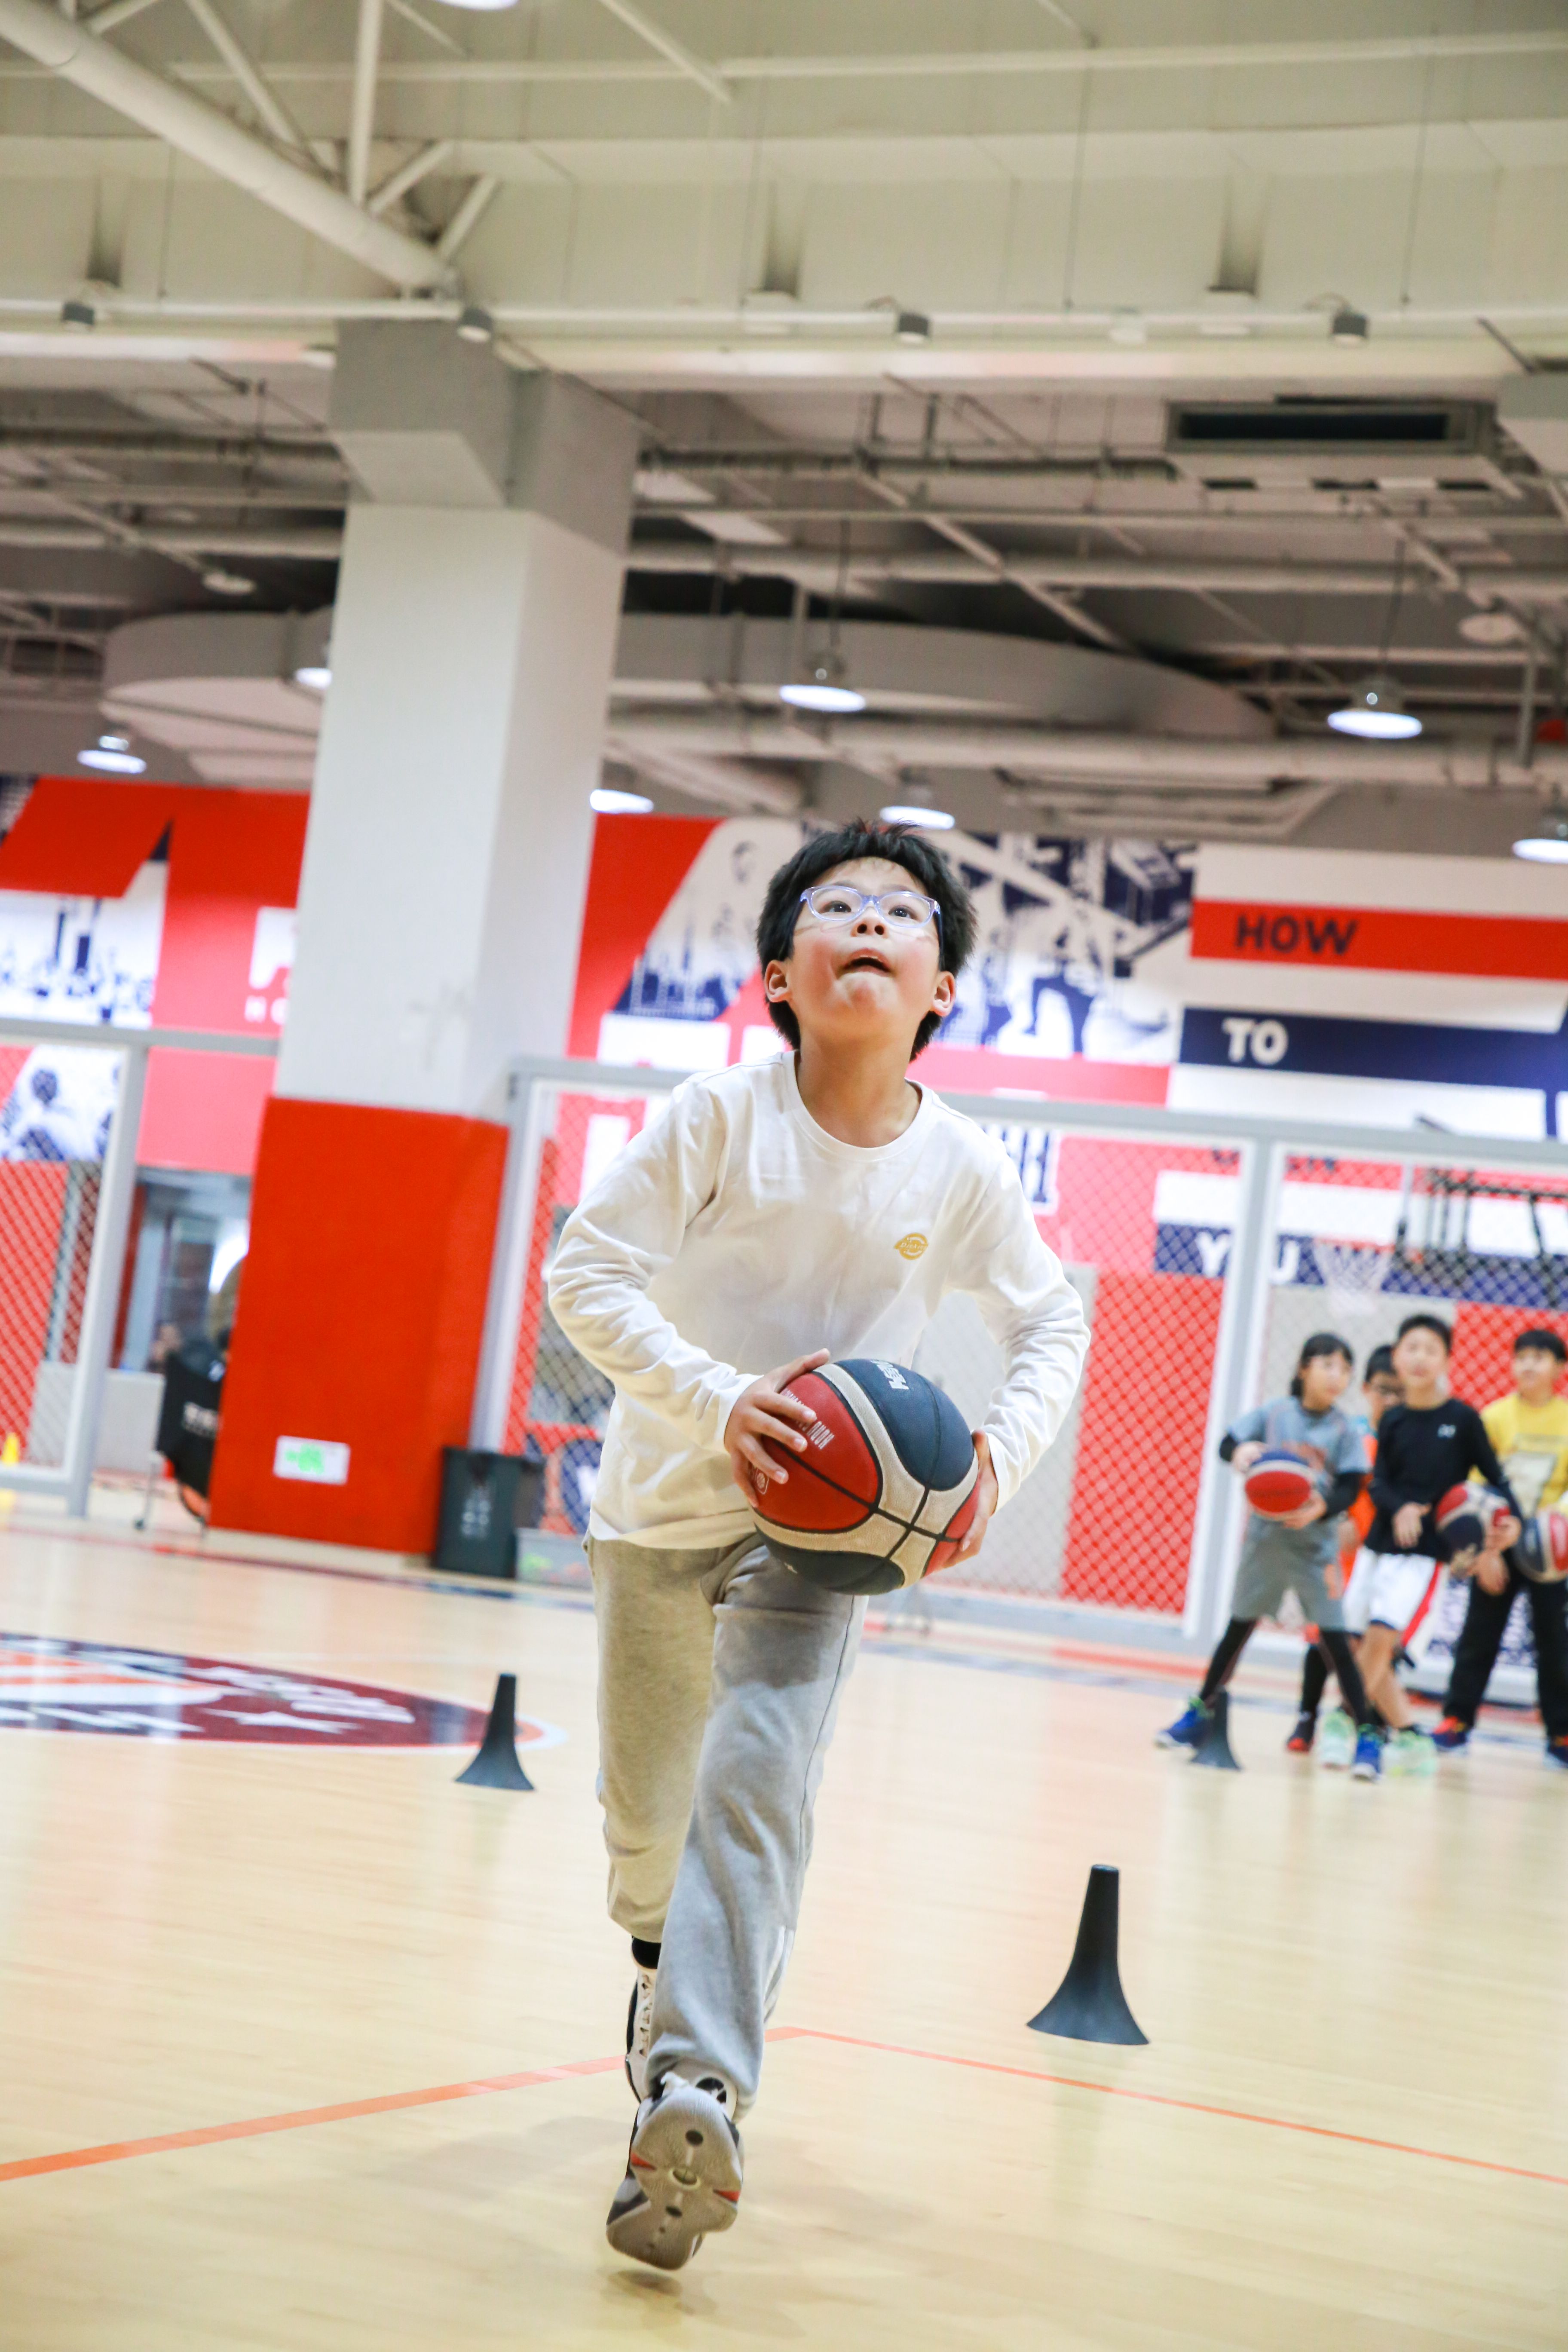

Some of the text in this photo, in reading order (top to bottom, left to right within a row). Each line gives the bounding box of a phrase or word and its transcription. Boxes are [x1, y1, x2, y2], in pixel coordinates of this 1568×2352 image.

[1236, 914, 1357, 954] HOW
[1222, 1017, 1289, 1065] TO
[1196, 1230, 1300, 1286] YU
